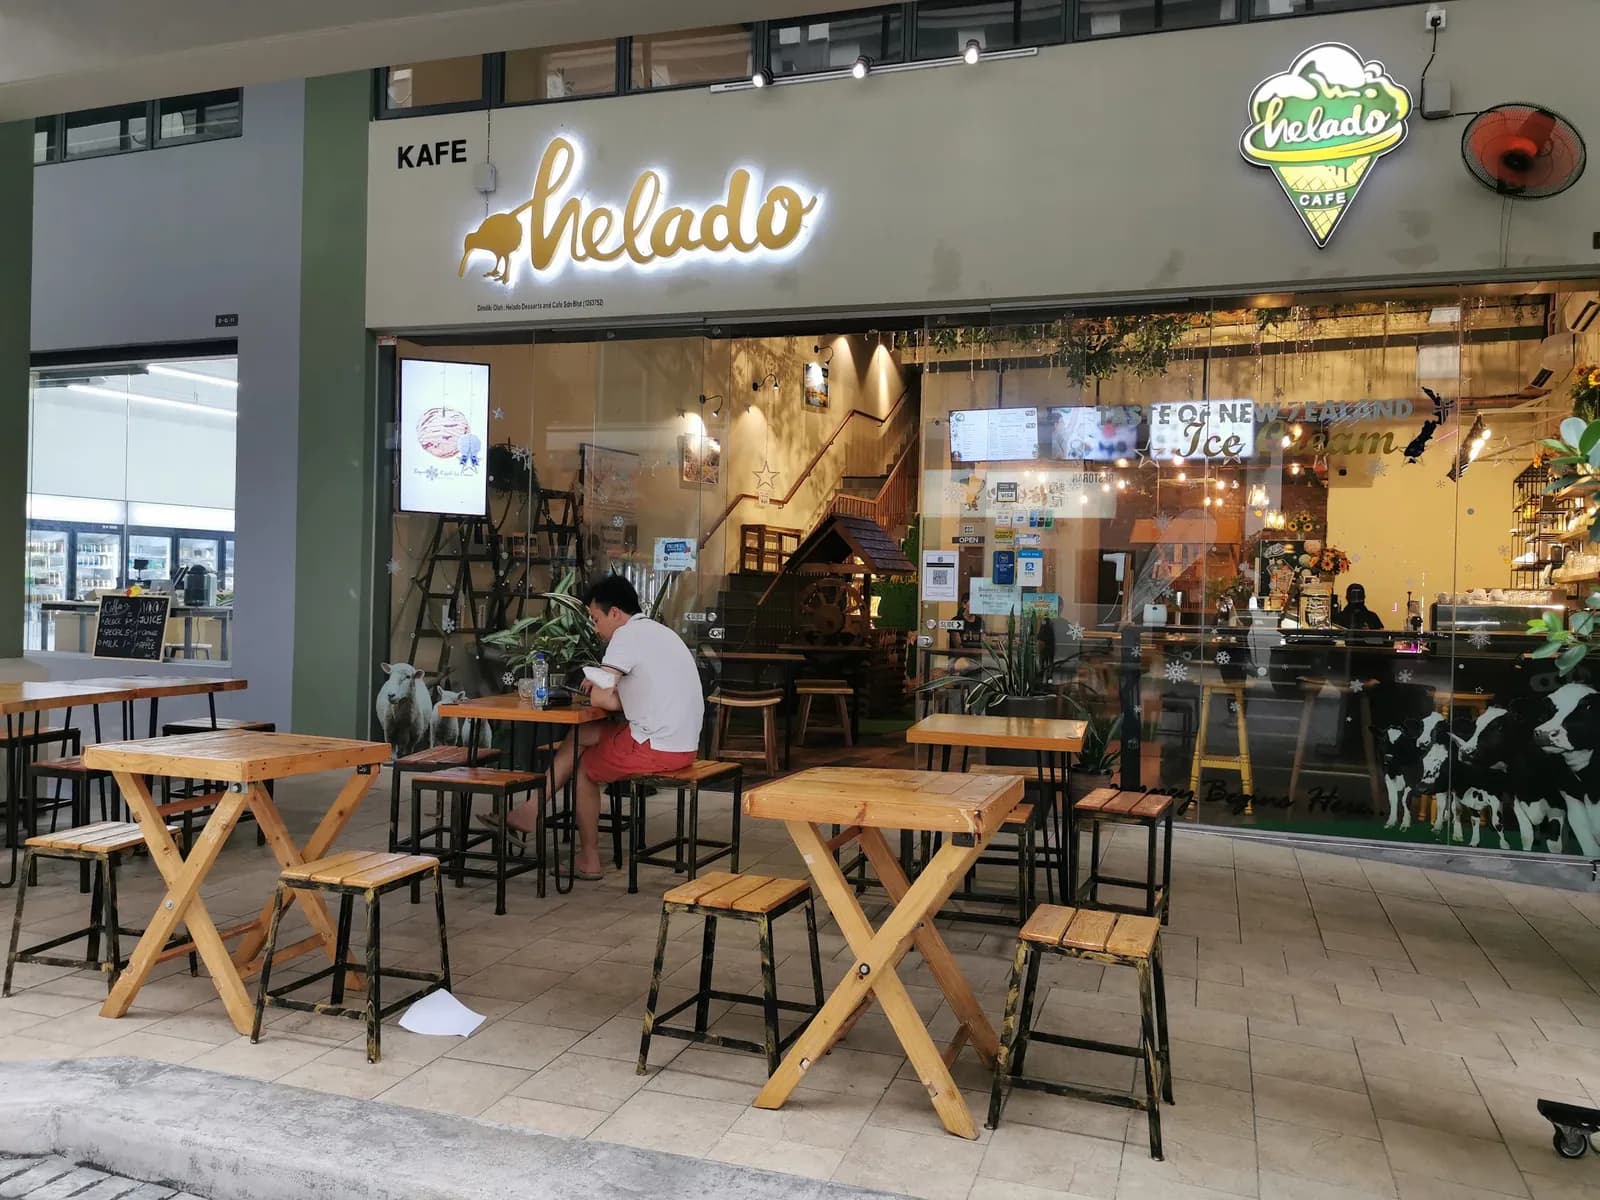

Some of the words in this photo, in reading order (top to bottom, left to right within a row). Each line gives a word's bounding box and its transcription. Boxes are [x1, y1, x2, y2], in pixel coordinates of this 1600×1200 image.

[1263, 97, 1391, 148] helado
[397, 139, 467, 170] KAFE
[528, 136, 817, 270] helado
[1299, 192, 1347, 206] CAFE
[1096, 405, 1171, 425] TASTE
[1178, 404, 1210, 424] OF
[1219, 402, 1280, 424] NEW
[1286, 399, 1413, 423] ZEALAND
[1177, 422, 1245, 458] Ice
[139, 615, 163, 625] JUICE
